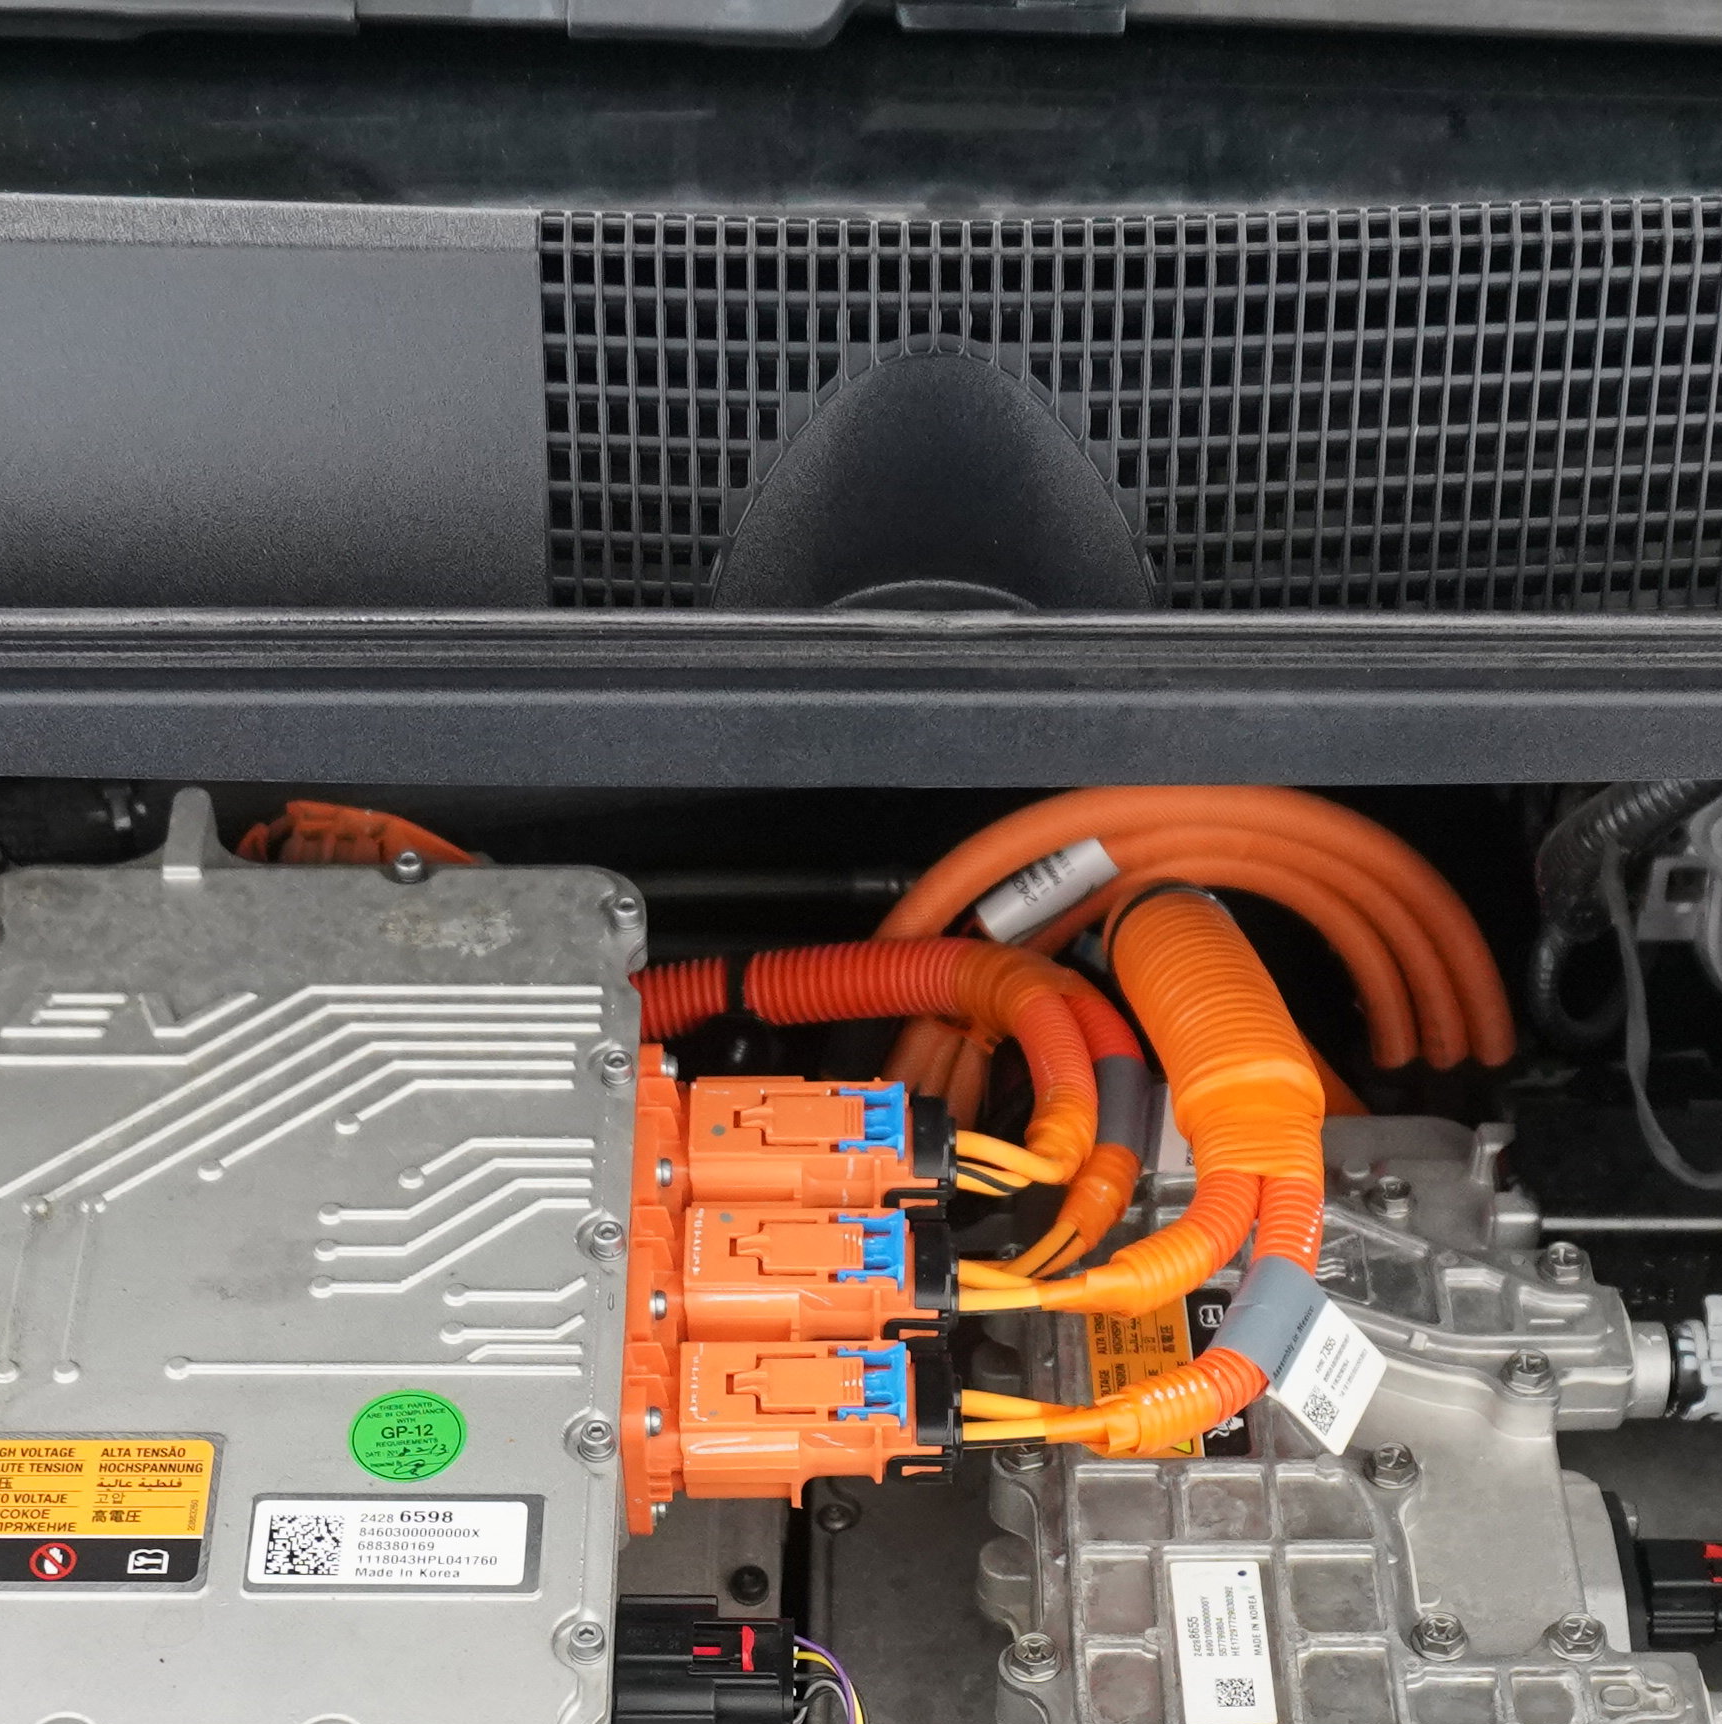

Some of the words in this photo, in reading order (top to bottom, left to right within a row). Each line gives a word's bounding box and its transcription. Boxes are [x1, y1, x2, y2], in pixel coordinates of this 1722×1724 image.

[381, 1423, 434, 1440] GP-12
[375, 1438, 439, 1448] REQUIREMENTS
[20, 1447, 77, 1459] VOLTAGE
[100, 1447, 134, 1459] ALTA
[136, 1445, 187, 1459] TENSÃO
[28, 1462, 84, 1474] TENSION
[98, 1463, 204, 1475] HOCHSPANNUNG
[14, 1493, 68, 1504] VOLTAJE
[93, 1492, 126, 1505] 고압
[91, 1510, 142, 1523] 高電圧
[360, 1513, 394, 1524] 2428
[399, 1510, 455, 1524] 6598
[355, 1568, 394, 1579] Made
[400, 1568, 413, 1578] In
[419, 1568, 461, 1579] Korea
[1248, 1594, 1262, 1623] KOREA
[1251, 1633, 1264, 1657] MADE
